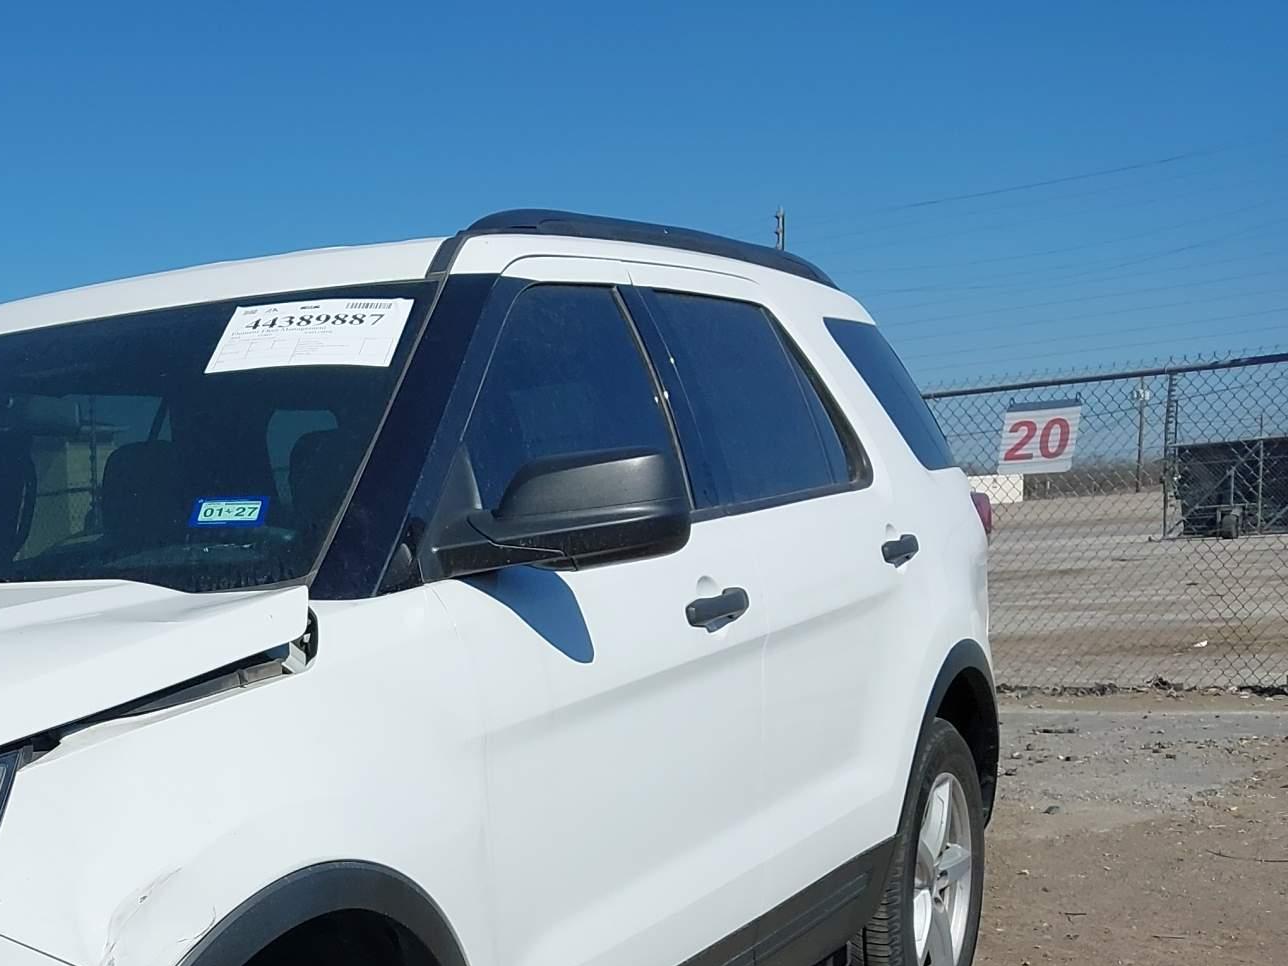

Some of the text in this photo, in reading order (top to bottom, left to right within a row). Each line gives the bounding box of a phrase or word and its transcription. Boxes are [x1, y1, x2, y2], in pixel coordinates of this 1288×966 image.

[245, 313, 385, 330] 44389887
[1004, 418, 1070, 461] 20
[203, 507, 258, 518] 01 27
